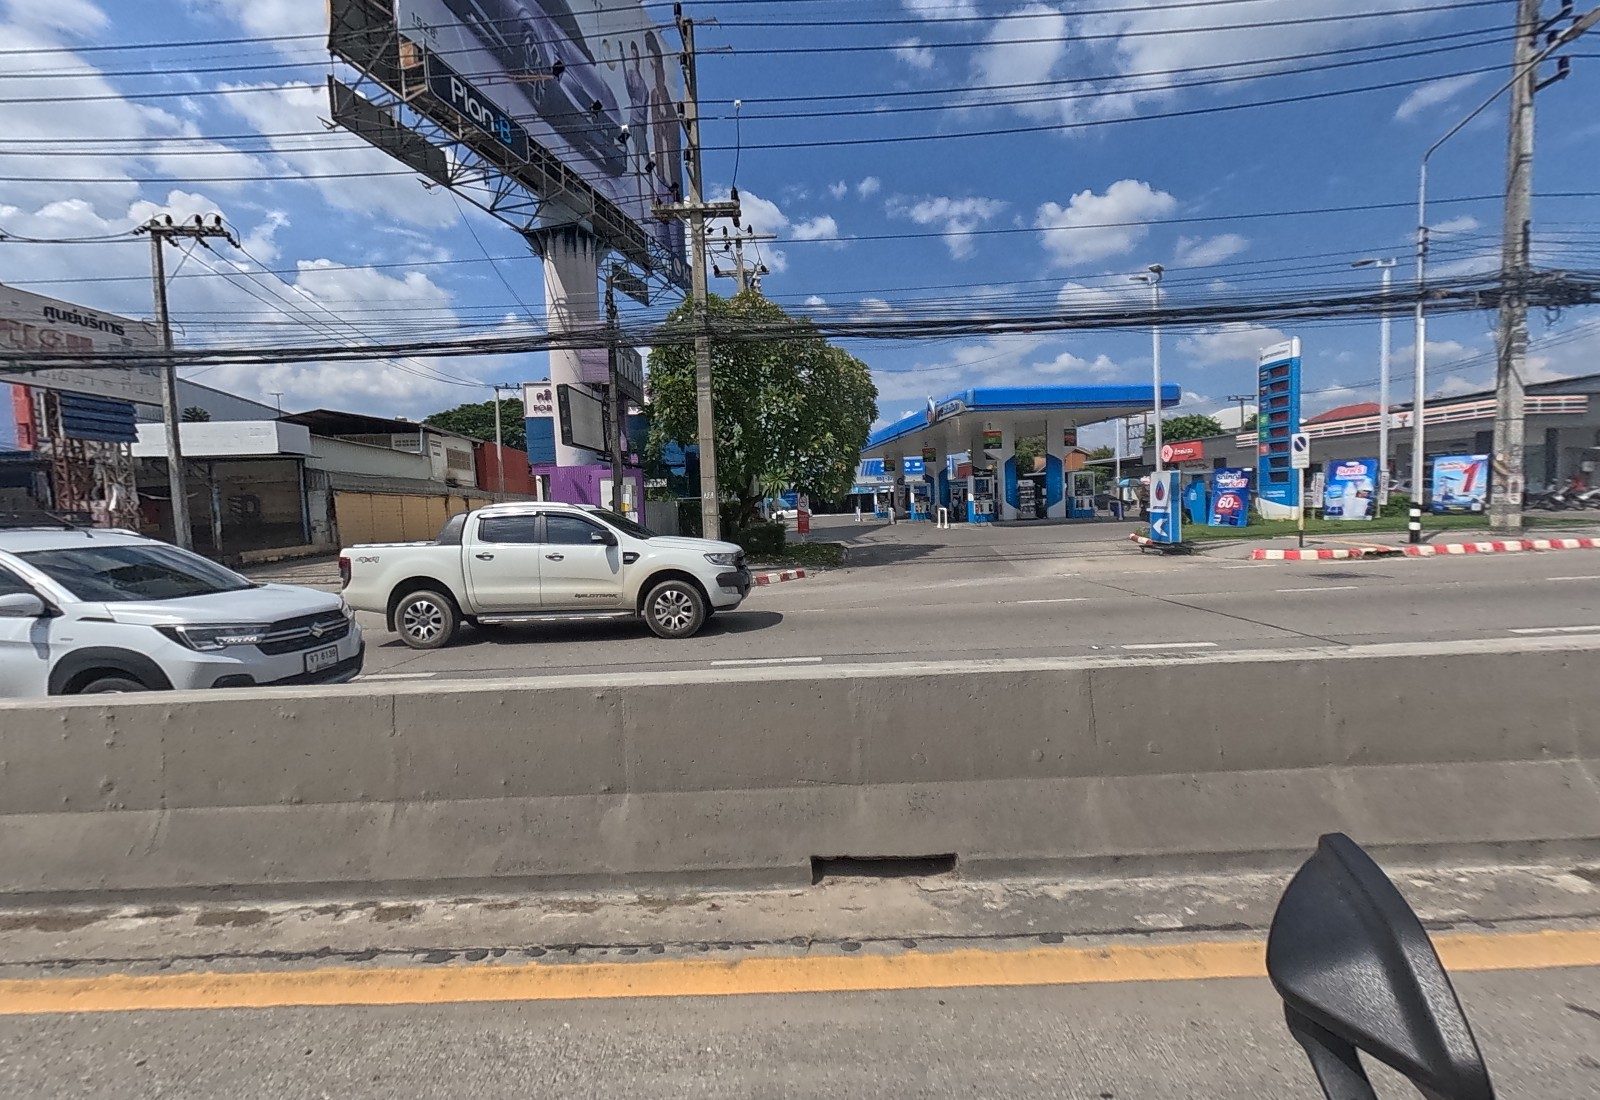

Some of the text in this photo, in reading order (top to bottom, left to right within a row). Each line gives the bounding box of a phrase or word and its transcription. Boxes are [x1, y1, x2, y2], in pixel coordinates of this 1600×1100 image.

[450, 76, 495, 133] Plan
[43, 305, 126, 337] ศูนย์บริการ
[1217, 496, 1234, 509] 60
